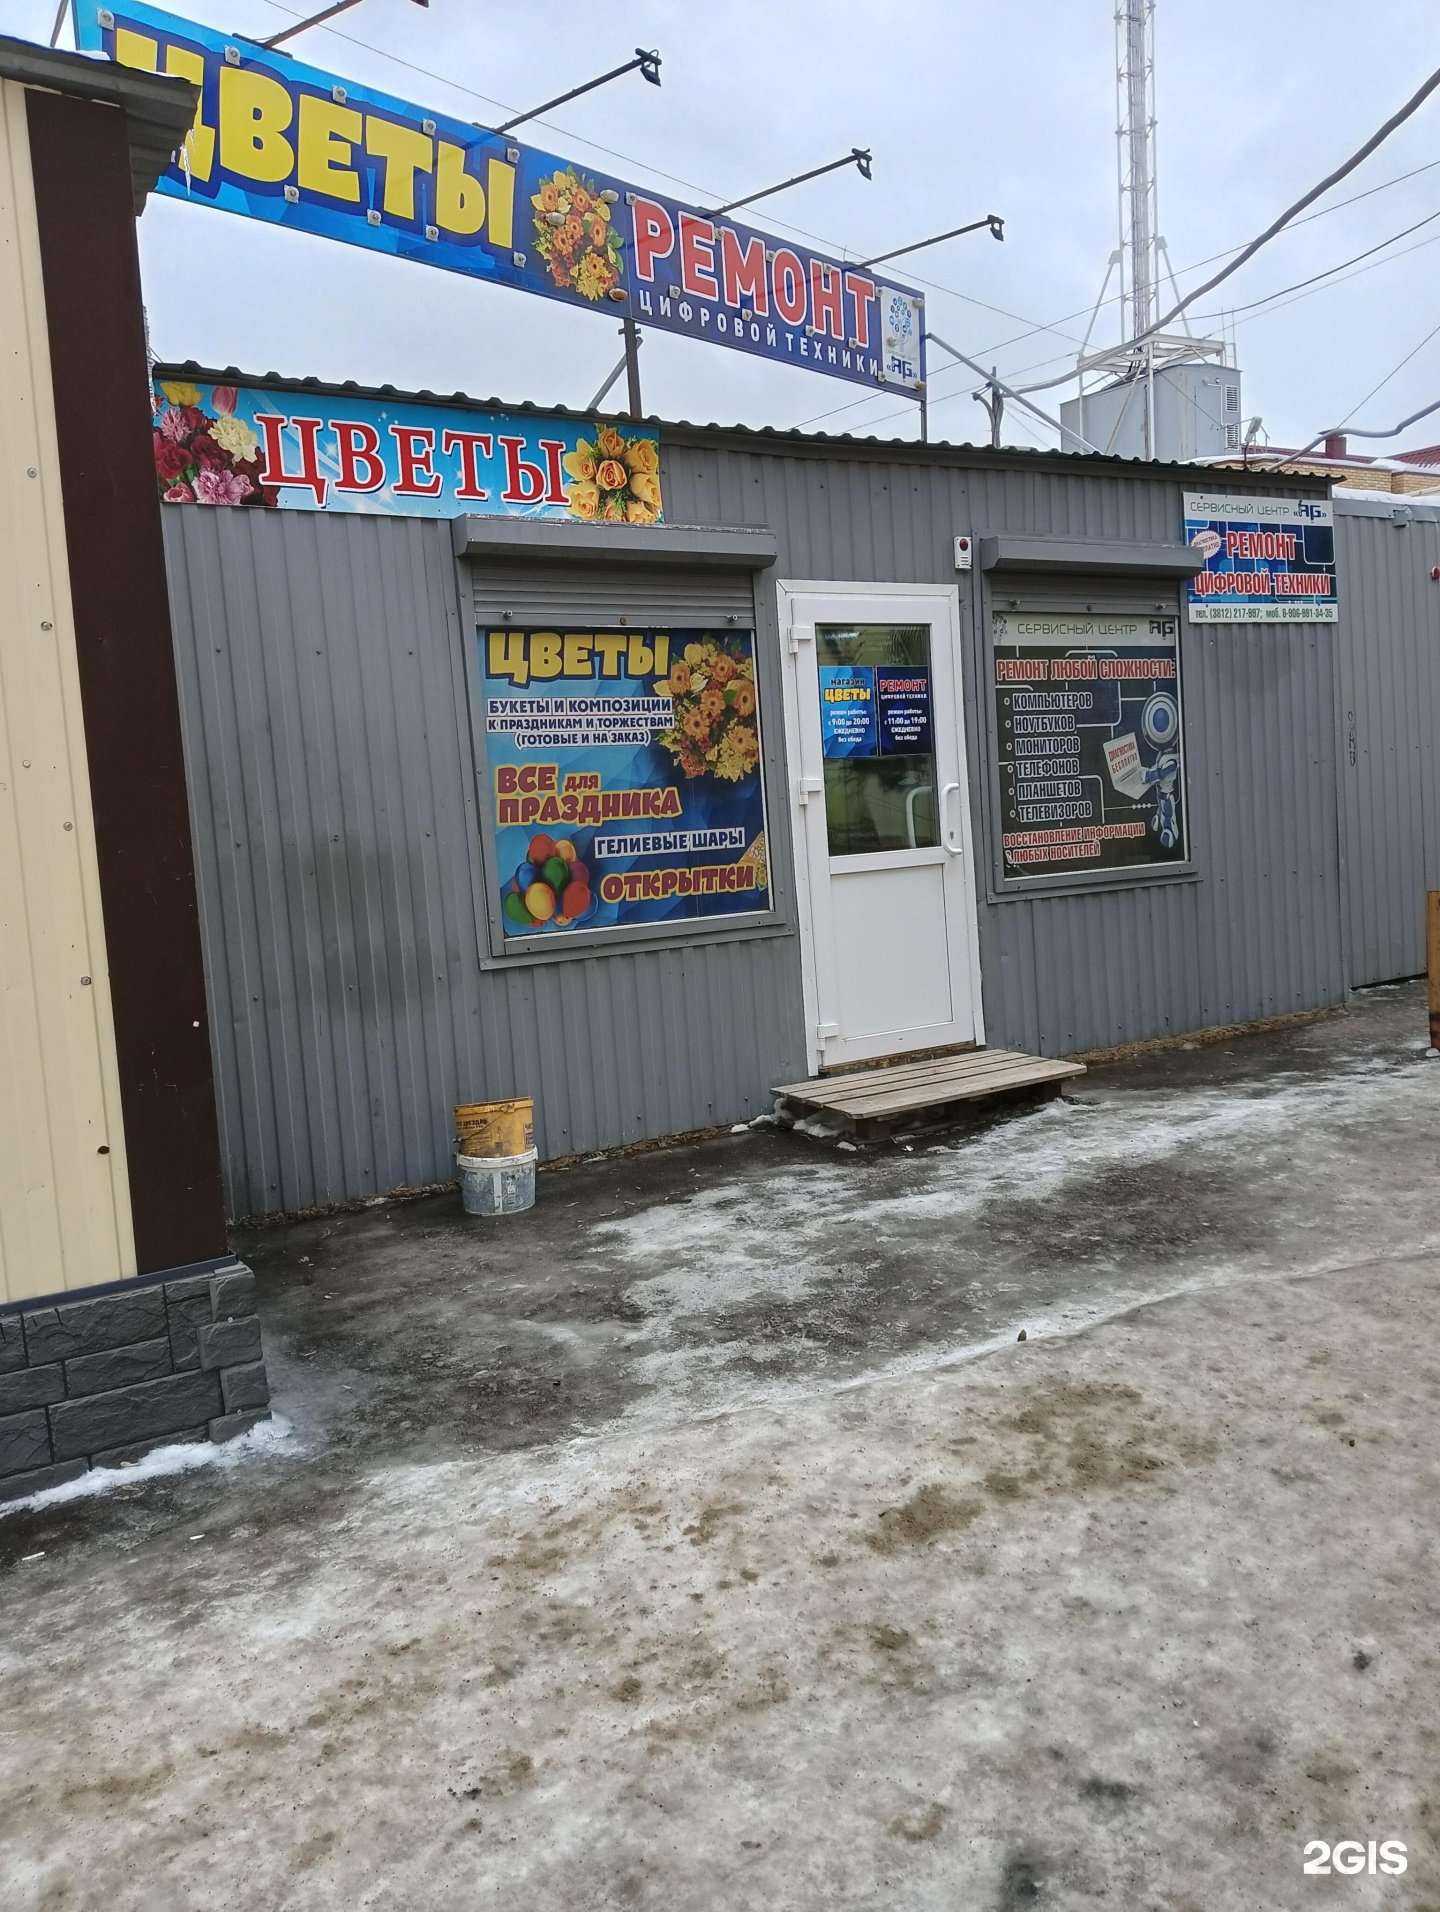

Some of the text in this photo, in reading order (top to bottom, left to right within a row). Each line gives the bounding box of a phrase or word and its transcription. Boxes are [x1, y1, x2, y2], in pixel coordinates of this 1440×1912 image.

[631, 194, 876, 349] РЕМОНТ
[639, 289, 879, 377] ЦИФРОВОЙ ТЕХНИКИ
[254, 412, 572, 507] ЦВЕТЫ
[1190, 501, 1254, 514] СЕРВИСНЫЙ
[1257, 505, 1290, 516] ЦЕНТР
[1226, 531, 1297, 560] РЕМОНТ
[1195, 568, 1331, 597] ЦИФРОВОЙ ТЕХНИКИ
[1209, 607, 1232, 619] (3812)
[1017, 622, 1094, 635] СЕРВИСНЫЙ
[1098, 623, 1138, 636] ЦЕНТР
[486, 631, 671, 686] ЦВЕТЫ
[996, 659, 1049, 681] РЕМОНТ
[1051, 655, 1098, 681] ЛЮБОЙ
[824, 688, 871, 703] ЦВЕТЫ
[880, 679, 927, 692] РЕМОНТ
[488, 698, 672, 715] БУКЕТЫ И КОМПОЗИЦИИ
[1012, 692, 1093, 711] КОМПЬЮТЕРОВ
[488, 716, 673, 731] К ПРАЗДНИКАМ И ТОРЖЕСТВАМ
[1014, 715, 1076, 734] НОУТБУКОВ
[515, 731, 651, 749] (ГОТОВЫЕ И НА ЗАКАЗ)
[1015, 737, 1081, 755] МОНИТОРОВ
[1016, 758, 1080, 777] ТЕЛЕФОНОВ
[496, 766, 556, 794] ВСЕ
[1017, 780, 1082, 800] ПЛАНШЕТОВ
[498, 789, 681, 825] ПРАЗДНИКА
[1019, 801, 1093, 822] ТЕЛЕВИЗОРОВ
[596, 828, 743, 856] ГЕЛИЕВЫЕ ШАРЫ
[1003, 822, 1146, 848] ВОССТАНОВЛЕНИЕ ИНФОРМАЦИИ
[1012, 847, 1049, 864] ЛЮБЫХ
[1049, 841, 1101, 860] НОСИТЕЛЕЙ
[601, 864, 755, 903] ОТКРЫТКИ
